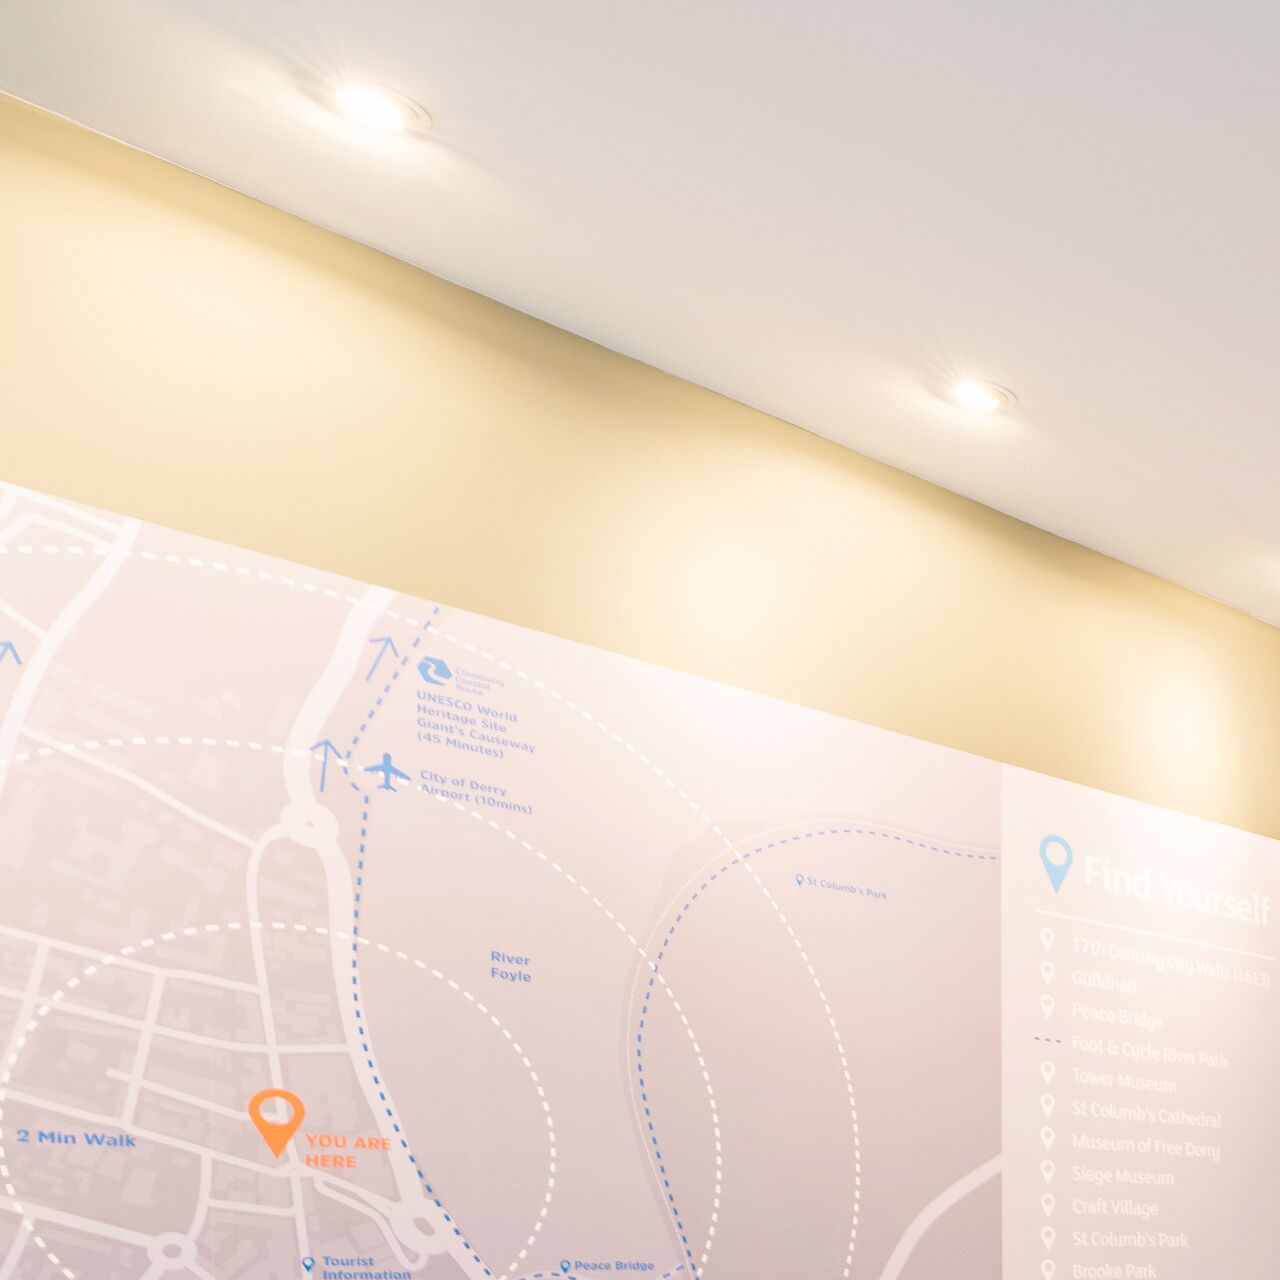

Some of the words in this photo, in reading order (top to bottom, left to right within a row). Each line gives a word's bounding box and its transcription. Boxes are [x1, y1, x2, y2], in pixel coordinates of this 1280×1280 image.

[417, 690, 472, 711] UNESCO
[477, 704, 518, 722] World
[417, 703, 476, 726] Heritage
[481, 719, 507, 733] Site
[417, 717, 465, 736] Giant's
[469, 729, 535, 754] Causeway
[417, 731, 441, 744] (45
[446, 736, 504, 759] Minutes)
[420, 769, 447, 785] City
[451, 777, 465, 788] of
[470, 779, 507, 797] Derry
[421, 783, 470, 802] Airport
[1084, 855, 1152, 898] Find
[1159, 873, 1272, 926] Yourself
[490, 951, 530, 965] River
[1073, 937, 1104, 955] 17th
[1109, 943, 1164, 970] Century
[1167, 955, 1194, 976] City
[1196, 960, 1232, 978] Walls
[491, 967, 532, 982] Foyle
[1072, 970, 1136, 993] Guildhall
[1072, 1001, 1117, 1019] Peace
[1120, 1009, 1164, 1031] Bridge
[1072, 1035, 1104, 1052] Foot
[1107, 1039, 1118, 1054] &
[1122, 1041, 1160, 1062] Cycle
[1163, 1046, 1195, 1064] River
[1198, 1052, 1228, 1068] Path
[1072, 1067, 1115, 1086] Tower
[1118, 1073, 1177, 1092] Museum
[1072, 1101, 1088, 1116] St
[1090, 1102, 1155, 1121] Columb's
[1160, 1109, 1222, 1128] Cathedral
[16, 1129, 30, 1143] 2
[37, 1130, 76, 1145] Min
[83, 1132, 137, 1148] Walk
[305, 1134, 347, 1149] YOU
[353, 1136, 391, 1151] ARE
[1072, 1133, 1134, 1151] Museum
[1138, 1138, 1152, 1152] of
[1155, 1139, 1182, 1154] Free
[1185, 1142, 1220, 1161] Derry
[305, 1153, 356, 1168] HERE
[1072, 1165, 1111, 1185] Siege
[1116, 1168, 1175, 1185] Museum
[1072, 1198, 1107, 1215] Craft
[1111, 1200, 1159, 1219] Village
[1072, 1231, 1088, 1247] St
[1091, 1231, 1156, 1247] Columb's
[1159, 1233, 1189, 1248] Park
[322, 1256, 375, 1267] Tourist
[575, 1261, 611, 1270] Peace
[615, 1261, 654, 1271] Bridge
[1072, 1263, 1121, 1279] Brooke
[1126, 1263, 1157, 1279] Park
[323, 1270, 412, 1280] Information
